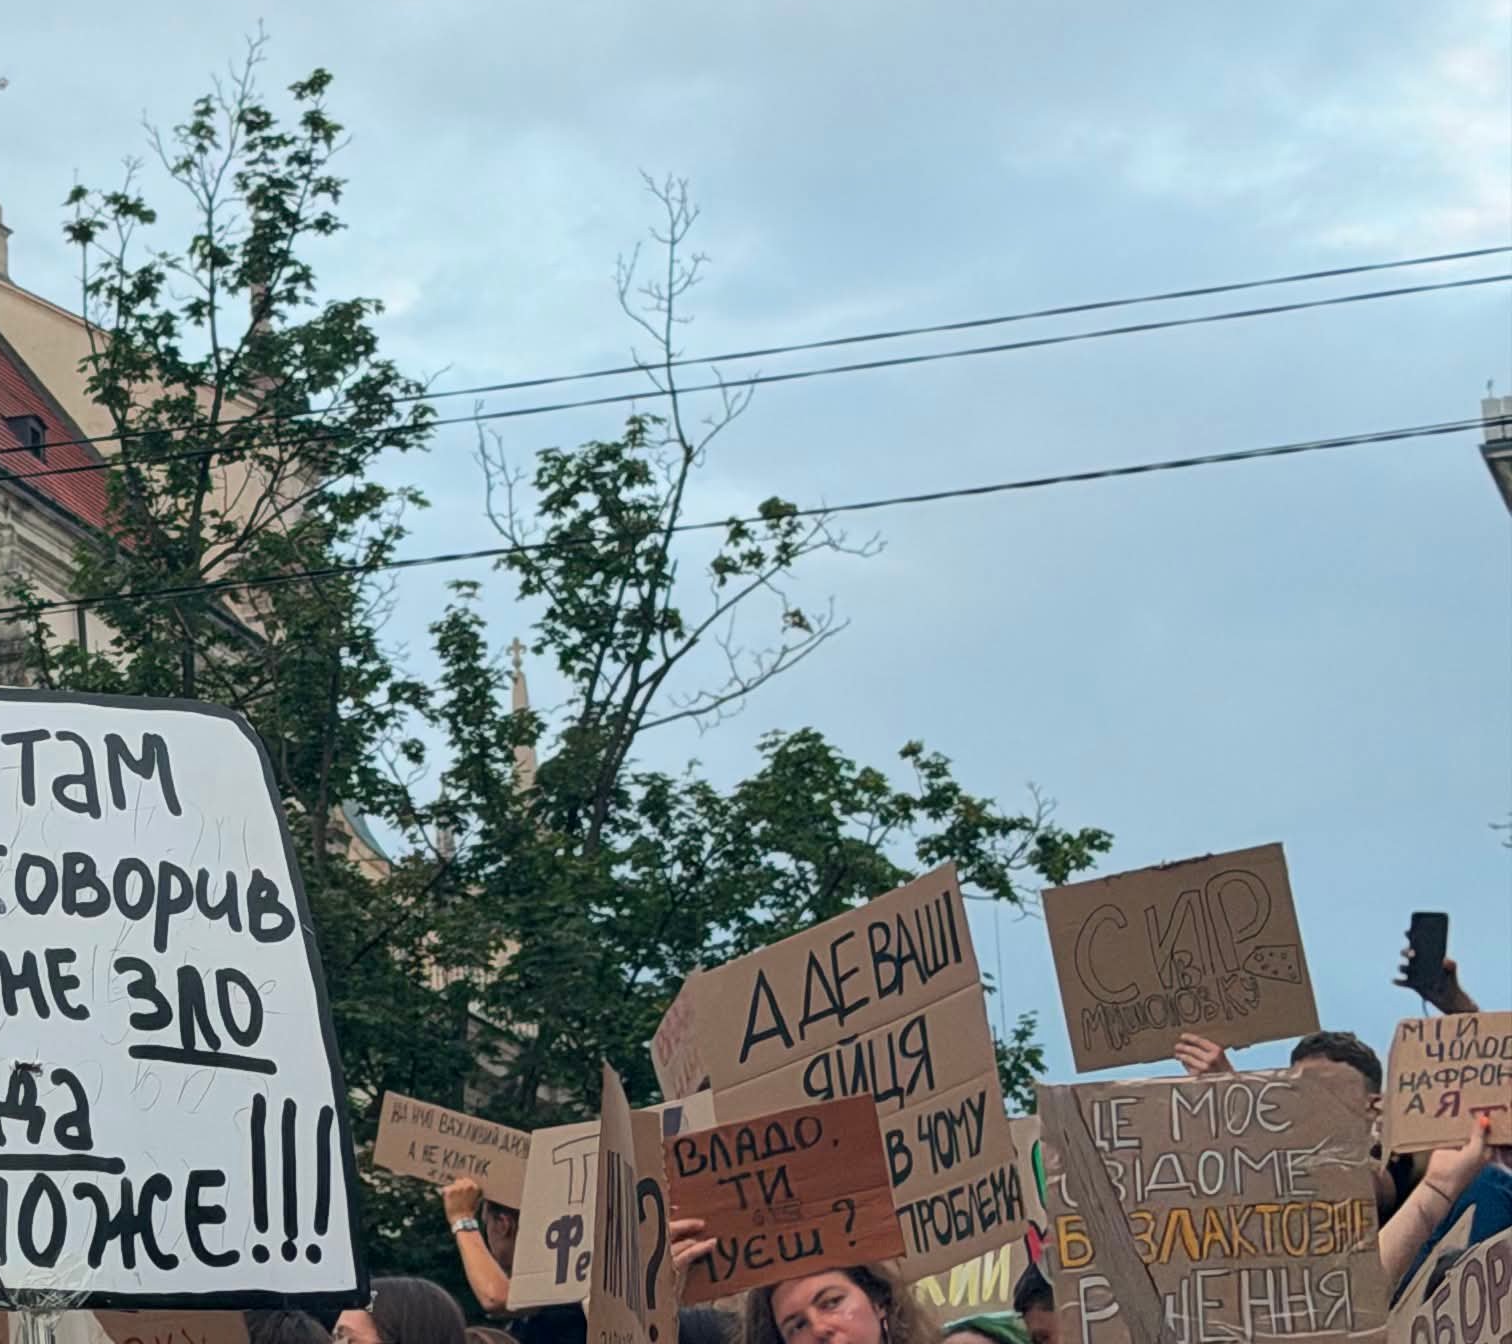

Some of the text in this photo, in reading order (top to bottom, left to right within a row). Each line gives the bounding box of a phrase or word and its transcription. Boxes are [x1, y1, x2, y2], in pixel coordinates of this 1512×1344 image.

[739, 969, 795, 1064] А
[798, 931, 871, 1041] ДЕ
[867, 890, 963, 1001] ВАШІ
[1075, 869, 1272, 1005] СИР
[113, 956, 265, 1054] ЗЛО
[917, 1091, 987, 1174] ЧОМУ
[1171, 1083, 1292, 1141] МОЄ
[1435, 1091, 1460, 1118] Я
[717, 1164, 794, 1210] ТИ
[895, 1163, 1025, 1254] ПРОБЛЕМА
[1056, 1200, 1373, 1269] БЗЛАКТОЗНЕ
